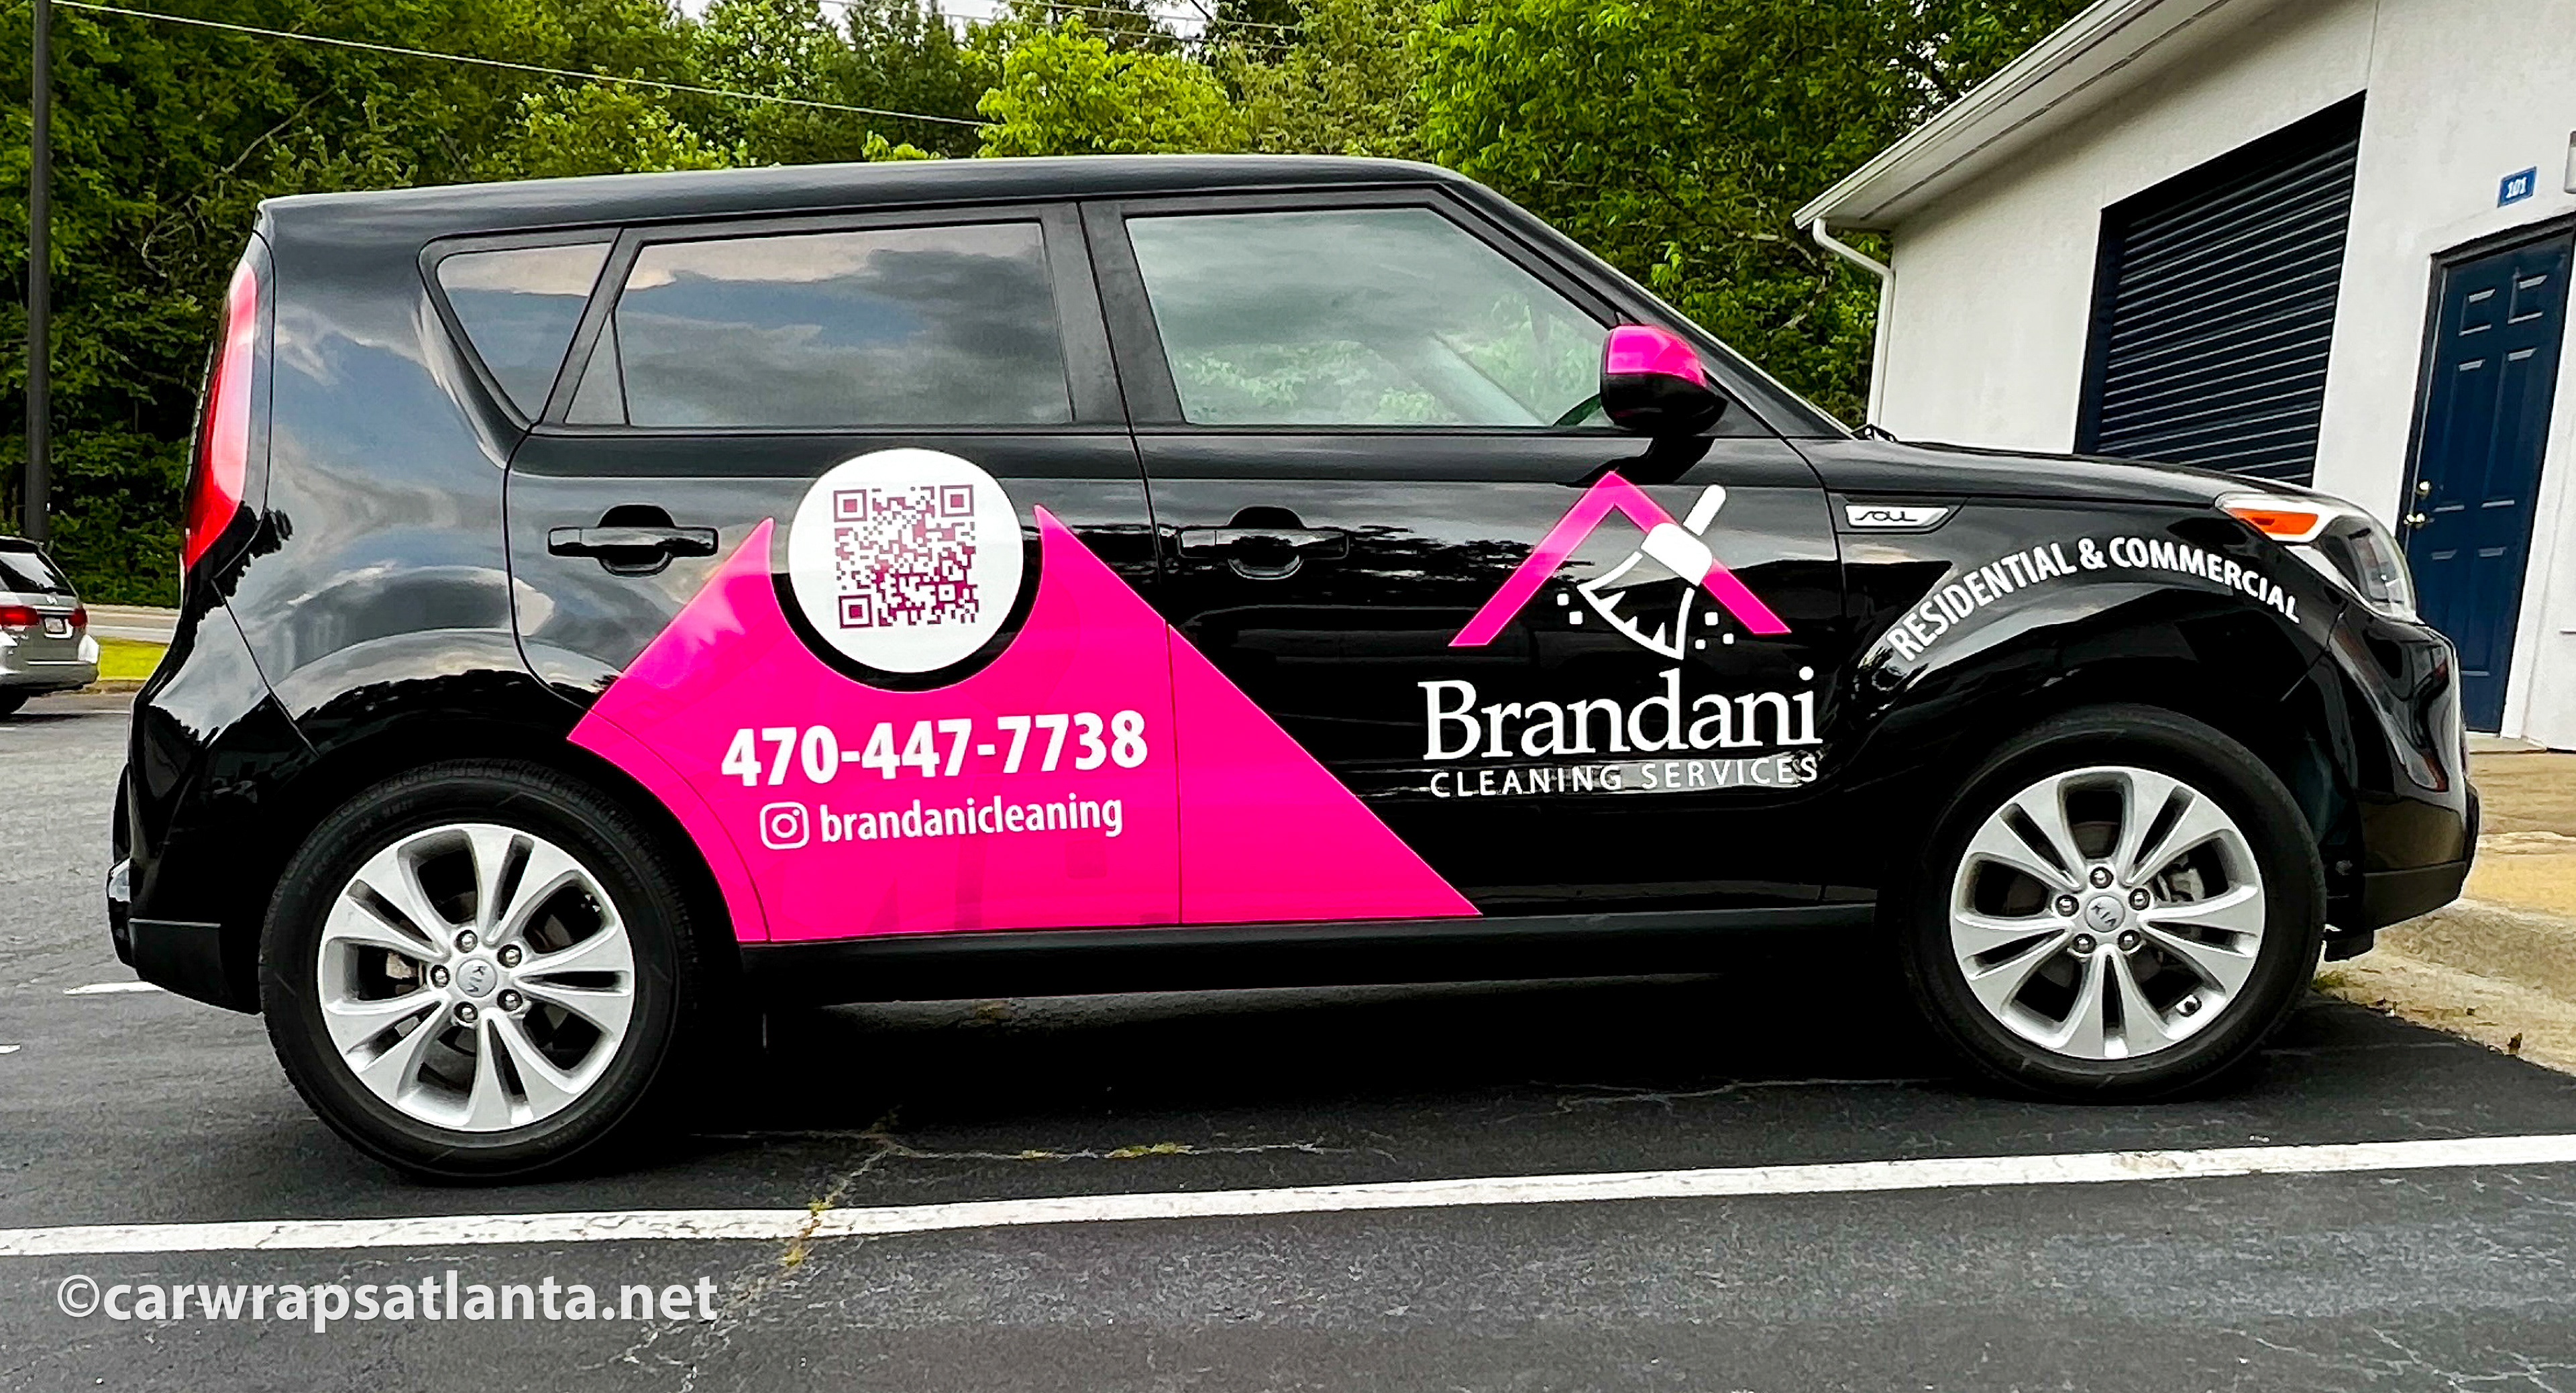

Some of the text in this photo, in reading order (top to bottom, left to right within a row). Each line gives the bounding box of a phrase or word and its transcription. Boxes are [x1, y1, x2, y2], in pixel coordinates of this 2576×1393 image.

[2506, 176, 2527, 199] 101
[1886, 537, 2301, 662] RESIDENTIAL & COMMERCIAL
[1417, 666, 1823, 760] Brandani
[720, 709, 1148, 787] 470-447-7738
[1430, 756, 1817, 798] CLEANING SERVICES
[819, 792, 1124, 843] brandanicleaning
